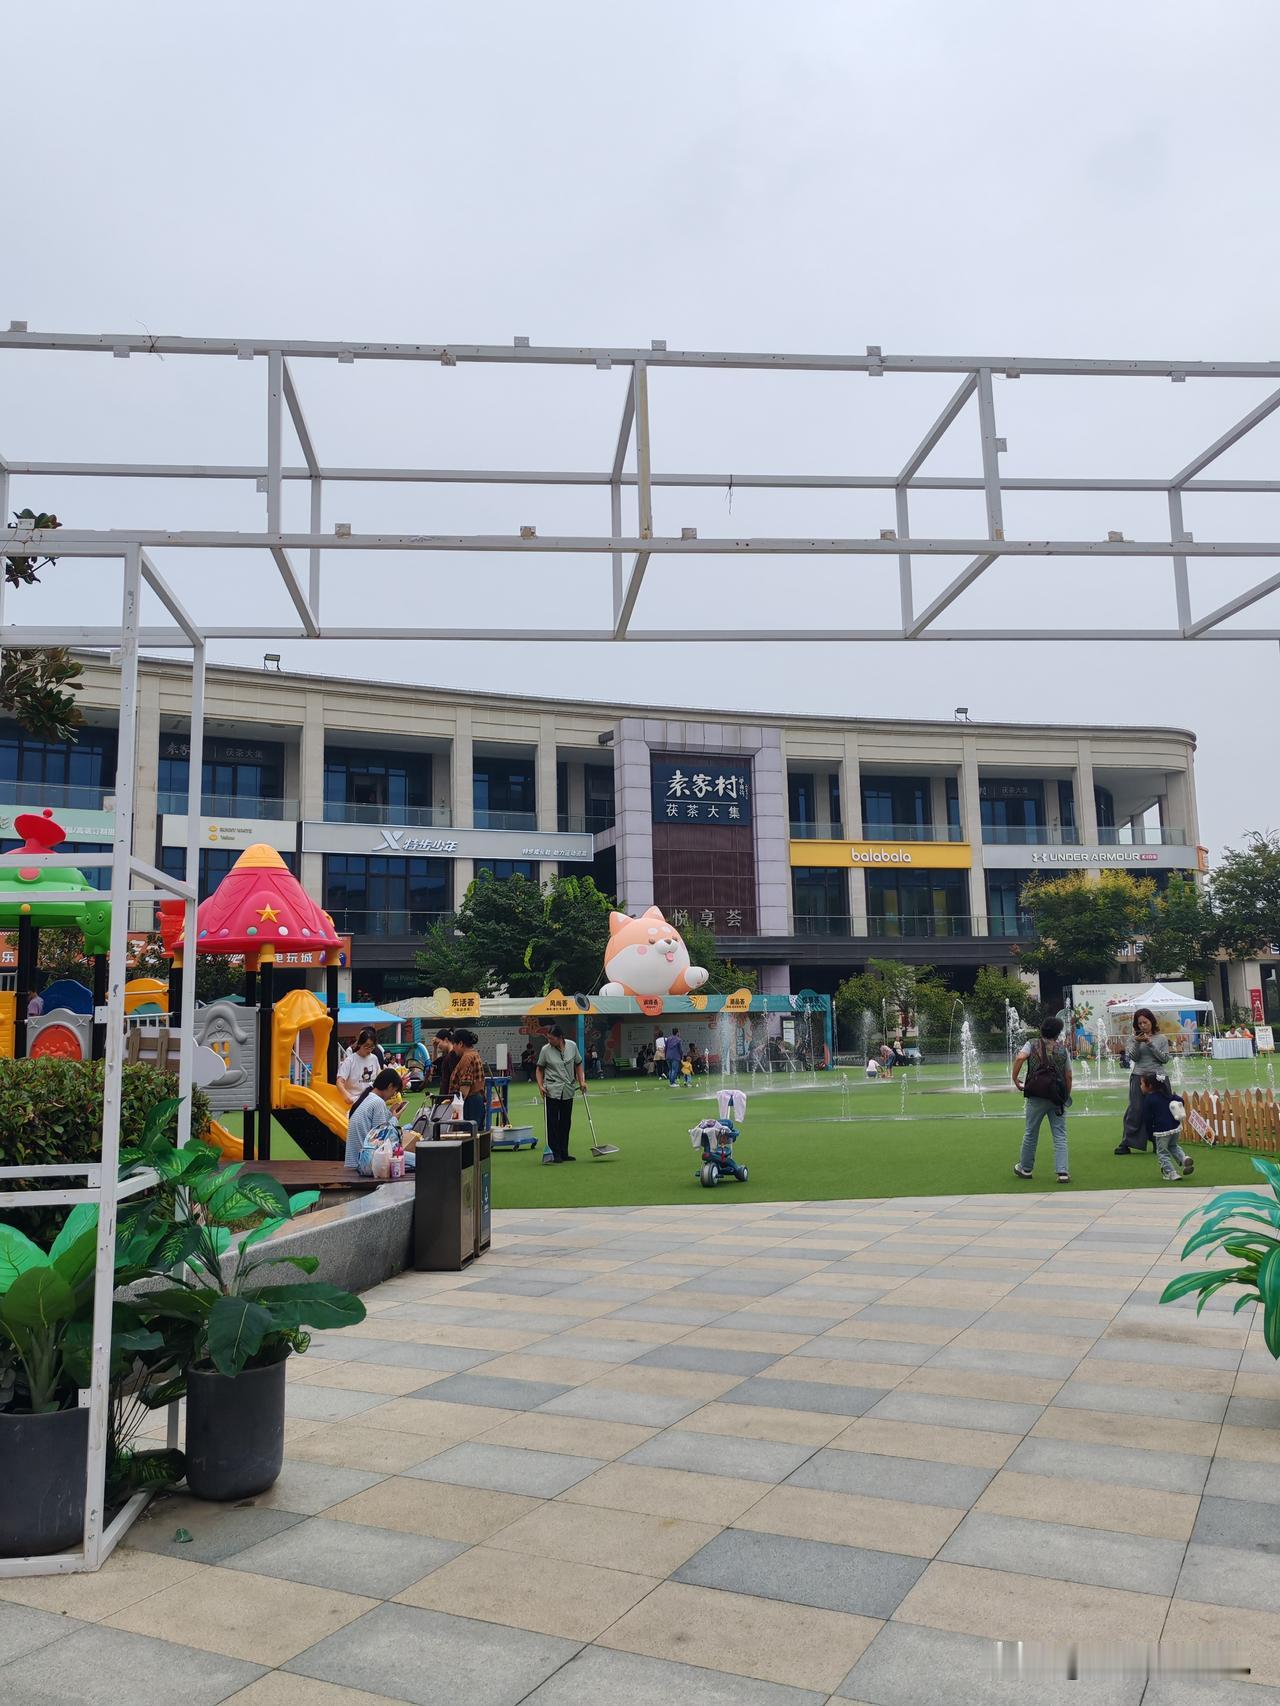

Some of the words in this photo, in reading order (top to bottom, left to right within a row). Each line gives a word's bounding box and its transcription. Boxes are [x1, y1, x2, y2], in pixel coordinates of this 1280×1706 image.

[666, 803, 740, 819] 茯茶大集
[403, 838, 457, 852] 特步少年
[851, 847, 912, 863] balabala
[1050, 852, 1088, 862] UNDER
[1090, 852, 1139, 862] ARMOUR
[673, 909, 742, 928] 悦享荟
[451, 998, 475, 1007] 乐活荟
